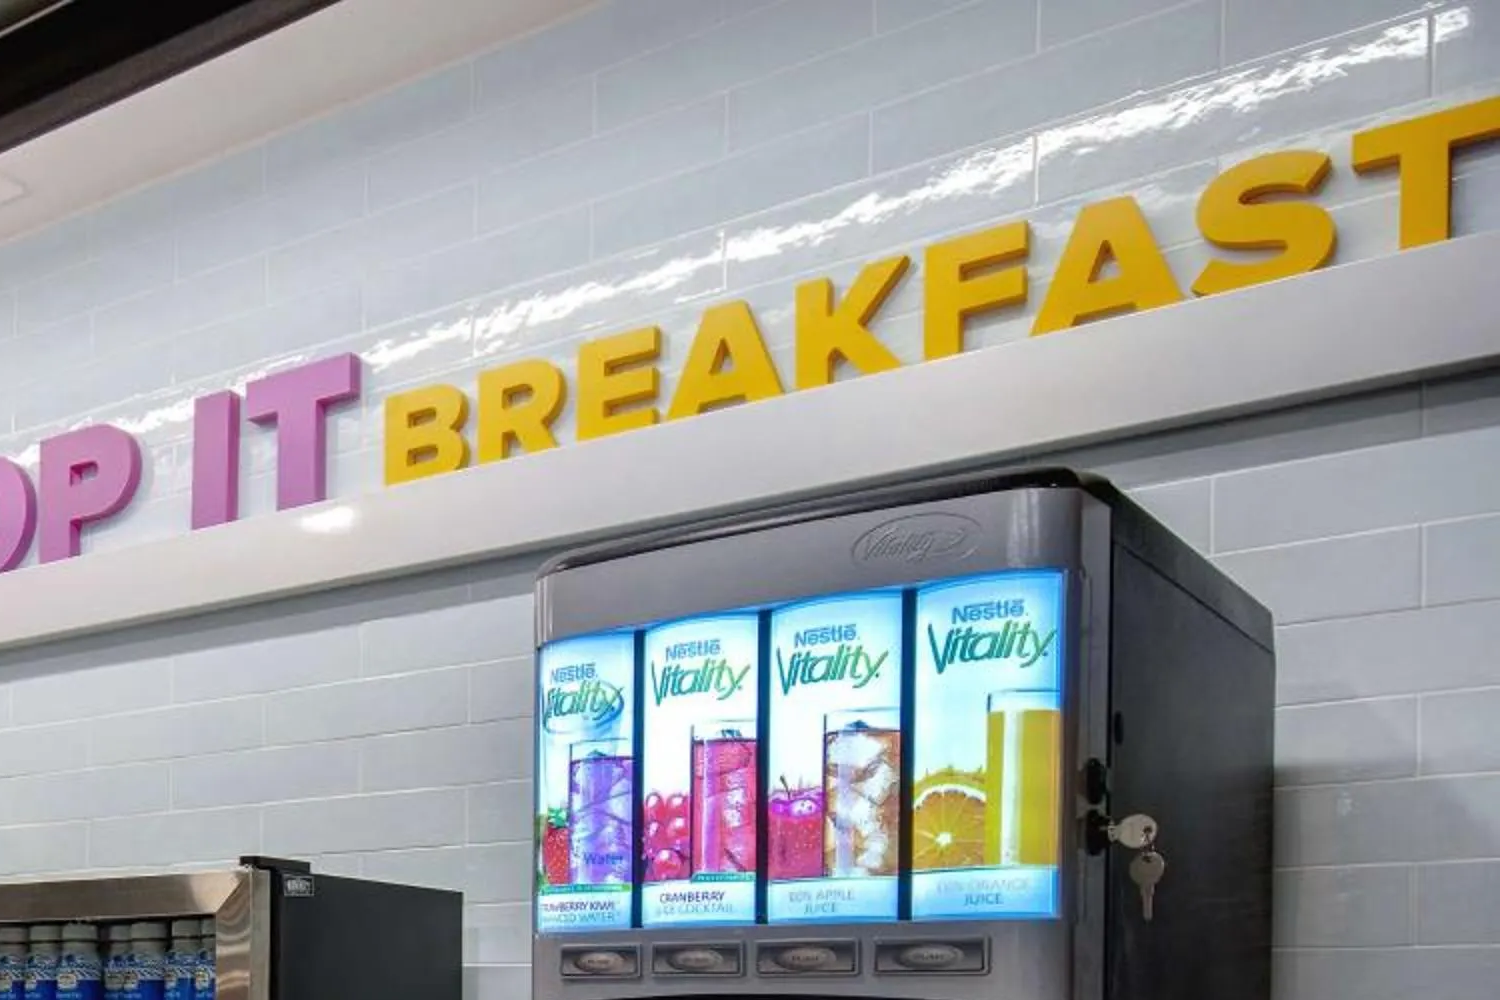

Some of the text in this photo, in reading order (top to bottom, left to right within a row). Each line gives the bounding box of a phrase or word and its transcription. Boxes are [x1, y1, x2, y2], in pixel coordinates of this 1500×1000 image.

[191, 352, 361, 531] IT
[384, 97, 1500, 486] BREAKFAST
[777, 644, 889, 696] Vitality
[928, 620, 1058, 676] Vitality
[651, 658, 751, 707] Vitality
[660, 891, 725, 903] CRANBERRY
[964, 892, 1004, 906] JUICE
